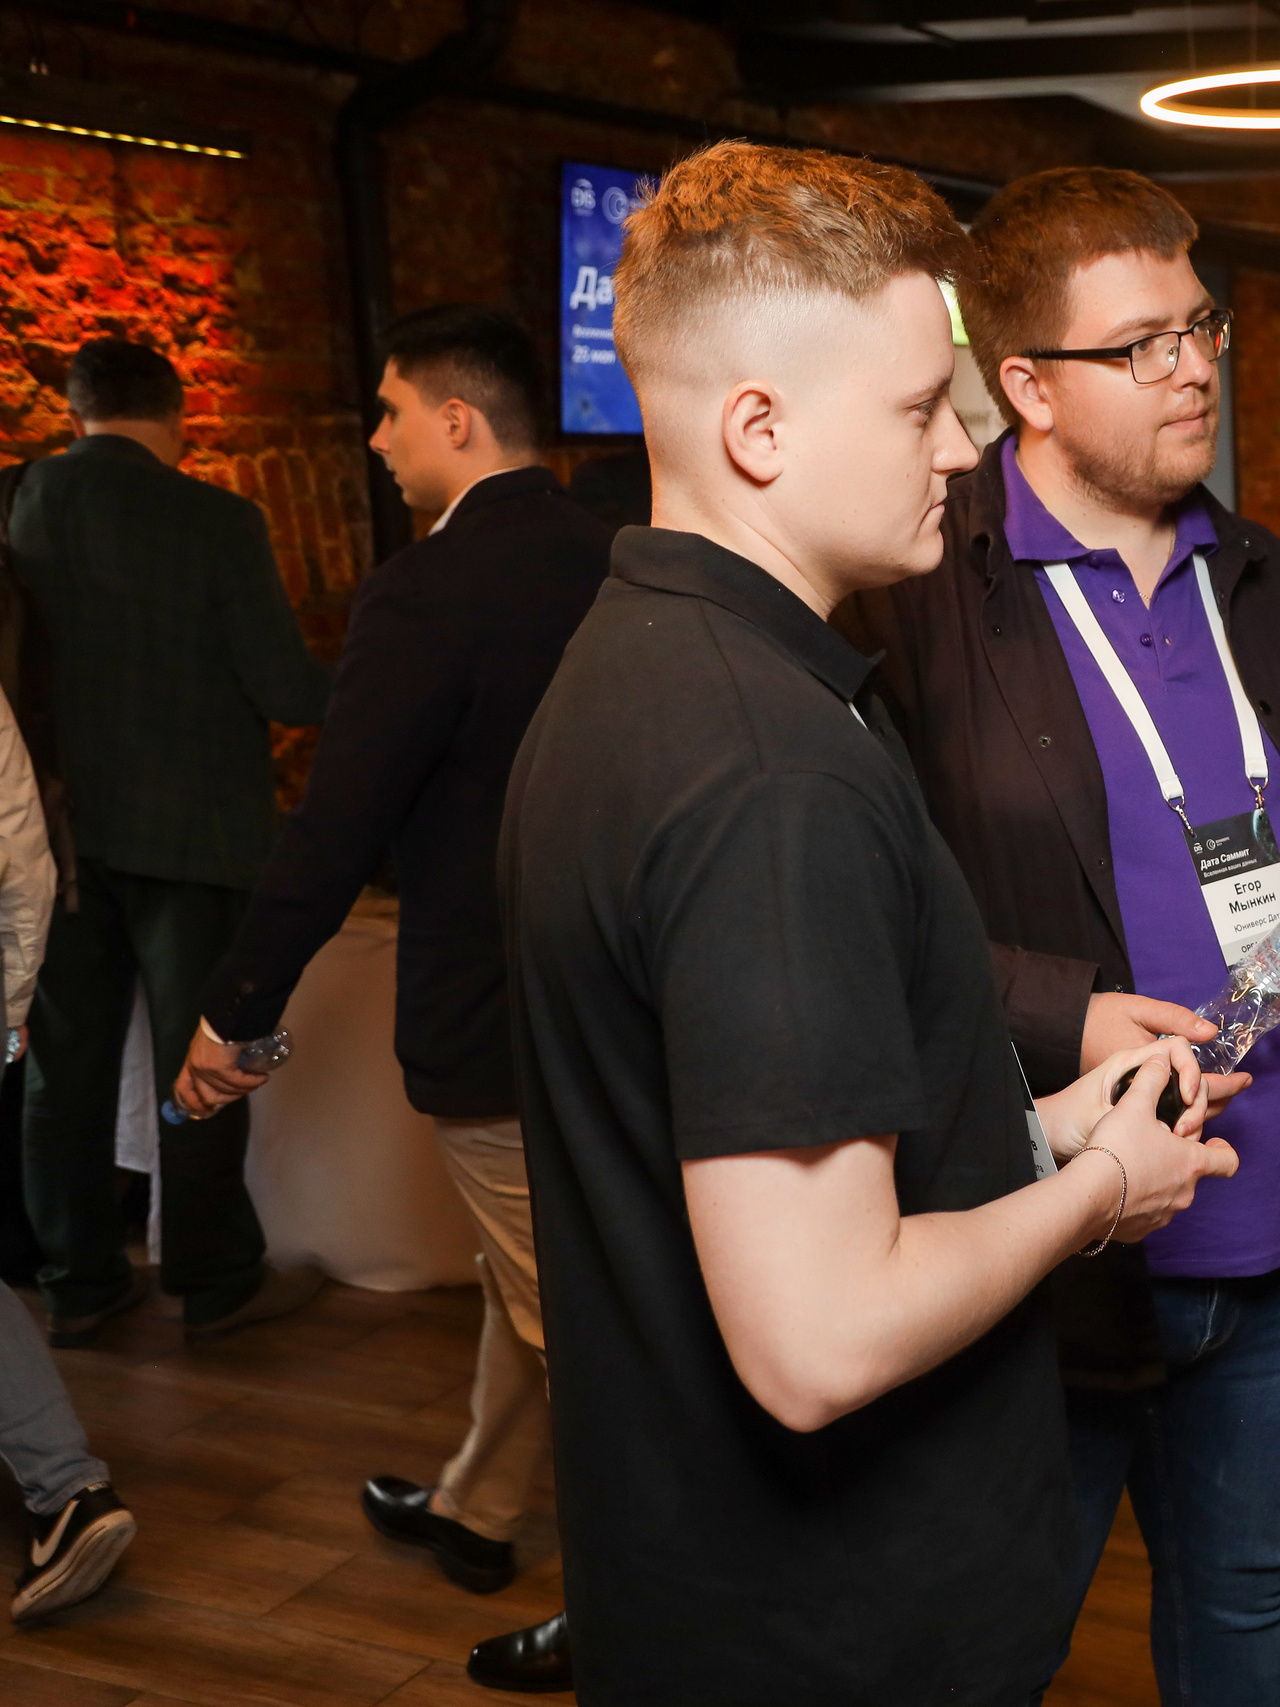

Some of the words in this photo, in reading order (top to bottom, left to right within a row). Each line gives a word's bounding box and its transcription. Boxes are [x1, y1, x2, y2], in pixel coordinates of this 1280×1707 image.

[569, 266, 615, 311] Да
[1200, 858, 1220, 871] Дата
[1220, 848, 1250, 863] Саммит
[1234, 880, 1262, 895] Егор
[1228, 892, 1277, 914] Мынкин
[1234, 917, 1267, 933] Юниверс
